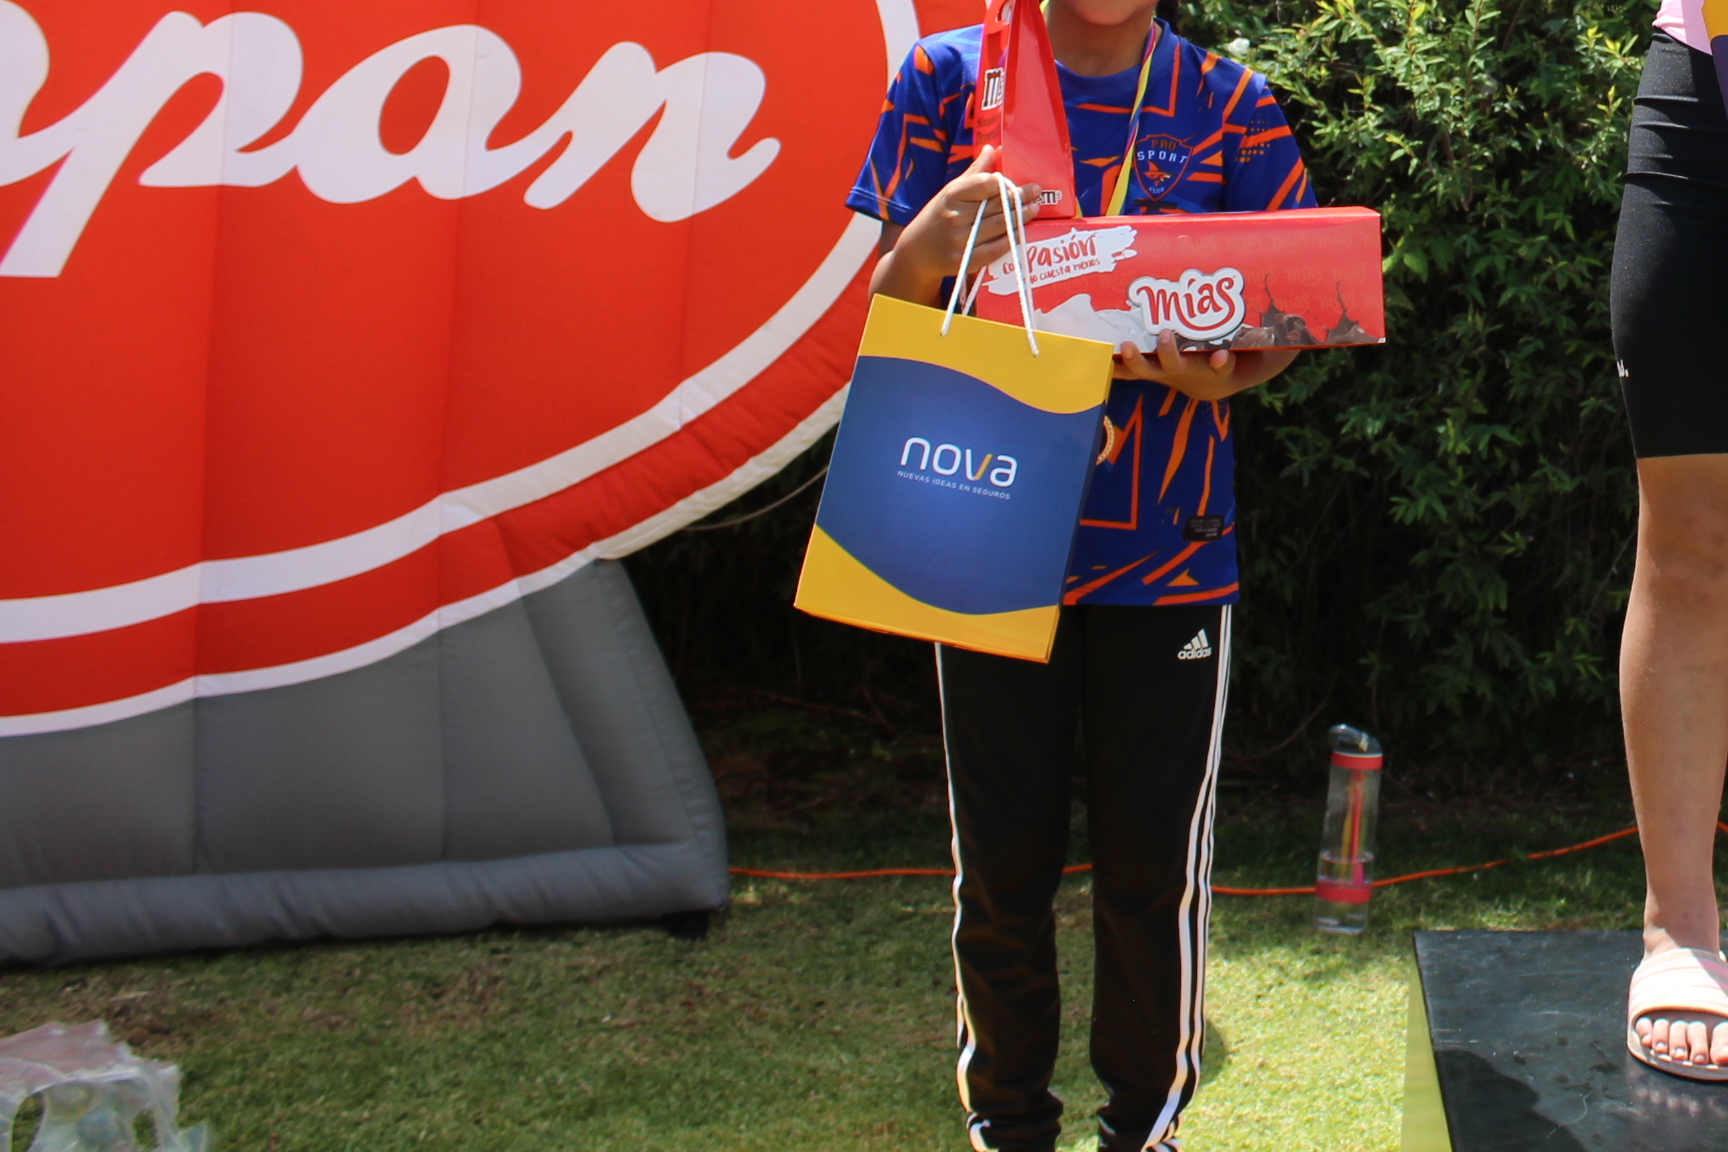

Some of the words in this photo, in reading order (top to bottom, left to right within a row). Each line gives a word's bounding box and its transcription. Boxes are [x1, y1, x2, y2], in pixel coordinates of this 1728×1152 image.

[1152, 139, 1177, 151] PRO
[1137, 150, 1188, 164] SPORT
[1039, 265, 1071, 280] cuesta
[1073, 258, 1101, 272] menos
[900, 436, 1018, 488] nova
[897, 470, 931, 484] NUEVAS
[932, 477, 957, 489] IDEAS
[958, 483, 971, 492] EN
[971, 486, 1011, 500] SEGUROS
[1177, 645, 1213, 660] adidas
